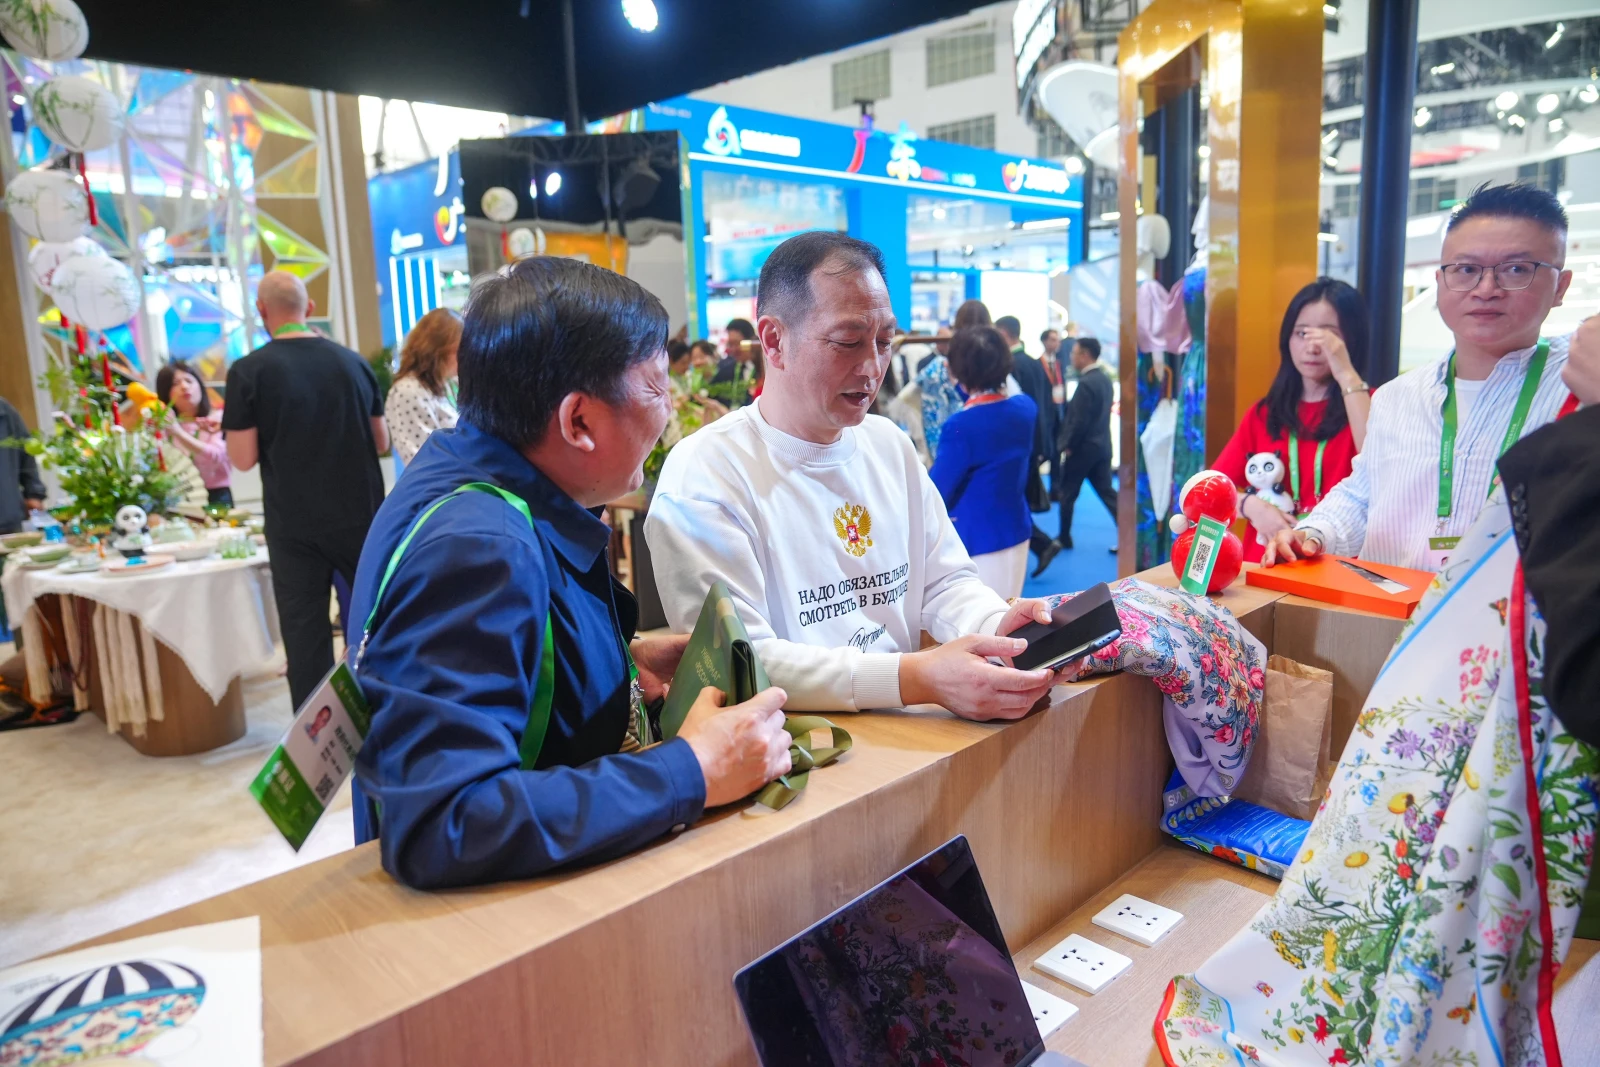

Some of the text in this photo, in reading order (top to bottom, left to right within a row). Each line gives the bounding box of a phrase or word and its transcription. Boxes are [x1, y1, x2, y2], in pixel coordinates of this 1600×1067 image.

[798, 562, 909, 605] НАДО ОБЯЗАТЕЛЬНО
[799, 597, 857, 627] СМОТРЕТЬ
[859, 595, 868, 608] В
